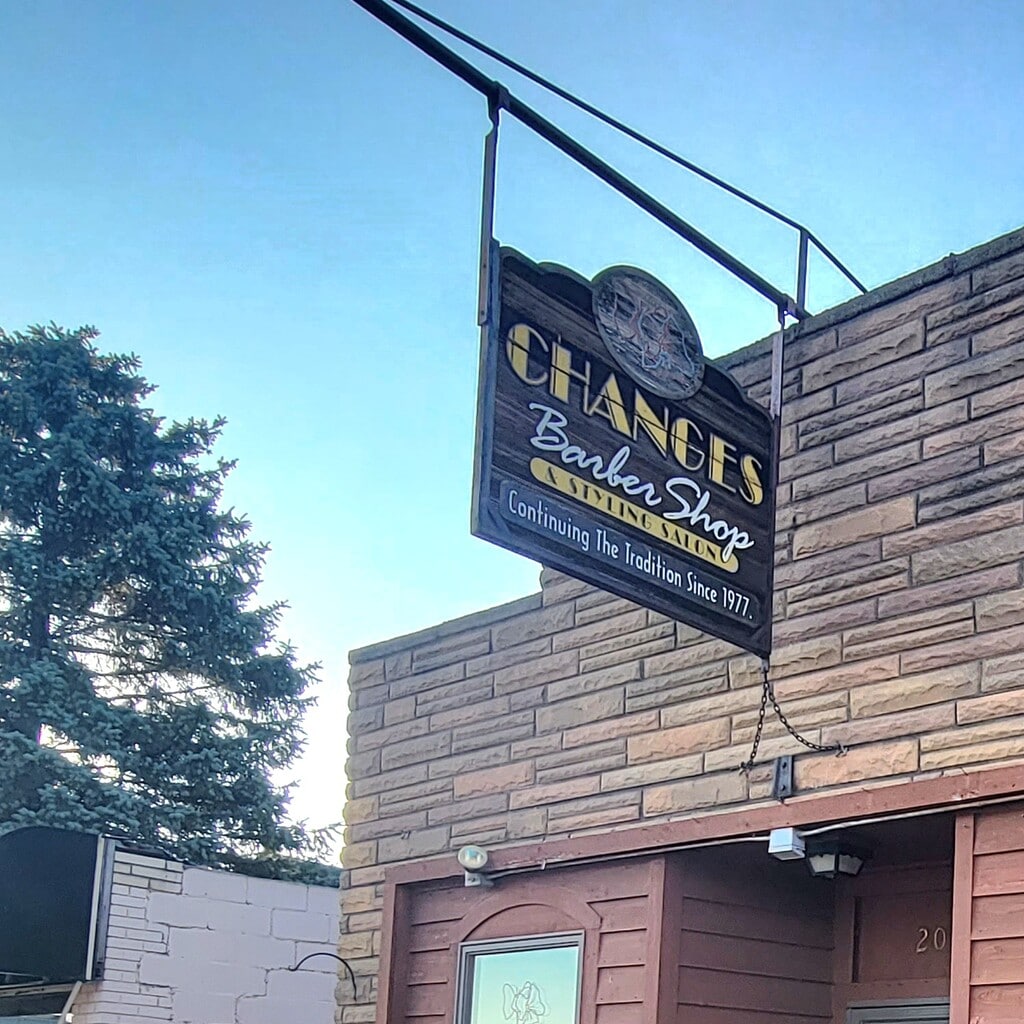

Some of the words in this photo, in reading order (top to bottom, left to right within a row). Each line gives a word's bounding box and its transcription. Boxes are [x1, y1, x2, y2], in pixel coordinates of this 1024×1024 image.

[506, 323, 764, 505] CHANGES
[529, 402, 662, 506] Barber
[663, 477, 755, 562] Shop
[508, 489, 590, 551] Continuing
[596, 529, 619, 560] The
[624, 541, 682, 588] Tradition
[687, 571, 718, 604] Since
[722, 586, 753, 620] 1977.
[543, 466, 557, 486] &
[569, 477, 652, 530] STYLING
[661, 523, 717, 562] SALON
